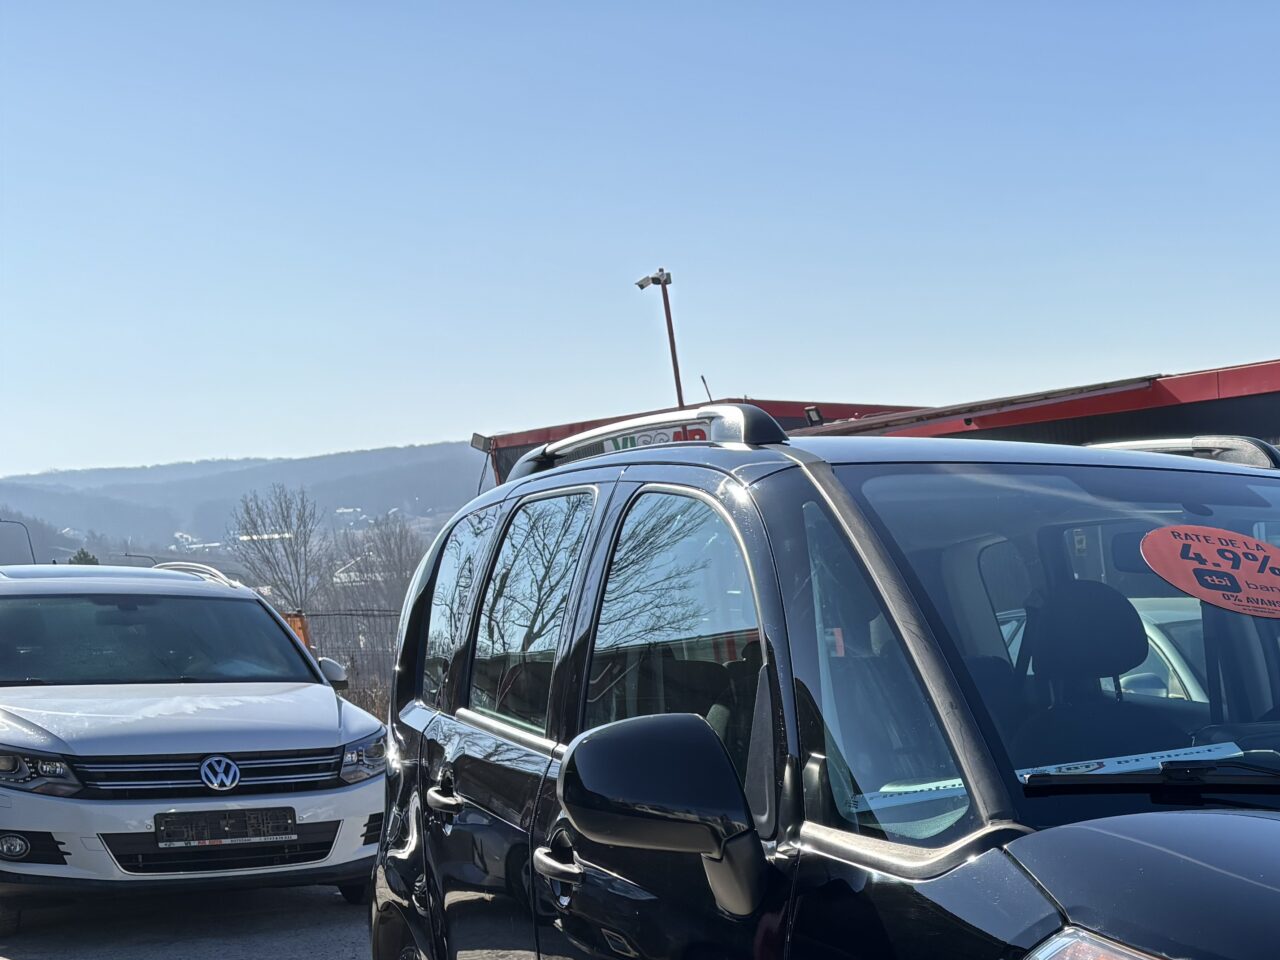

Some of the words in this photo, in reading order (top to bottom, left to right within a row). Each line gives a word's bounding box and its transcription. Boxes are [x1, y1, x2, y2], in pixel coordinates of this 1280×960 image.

[1171, 530, 1215, 545] RATE
[1217, 537, 1241, 549] DE
[1243, 541, 1266, 552] LA
[1203, 575, 1231, 587] tbi
[1222, 593, 1243, 604] 0%
